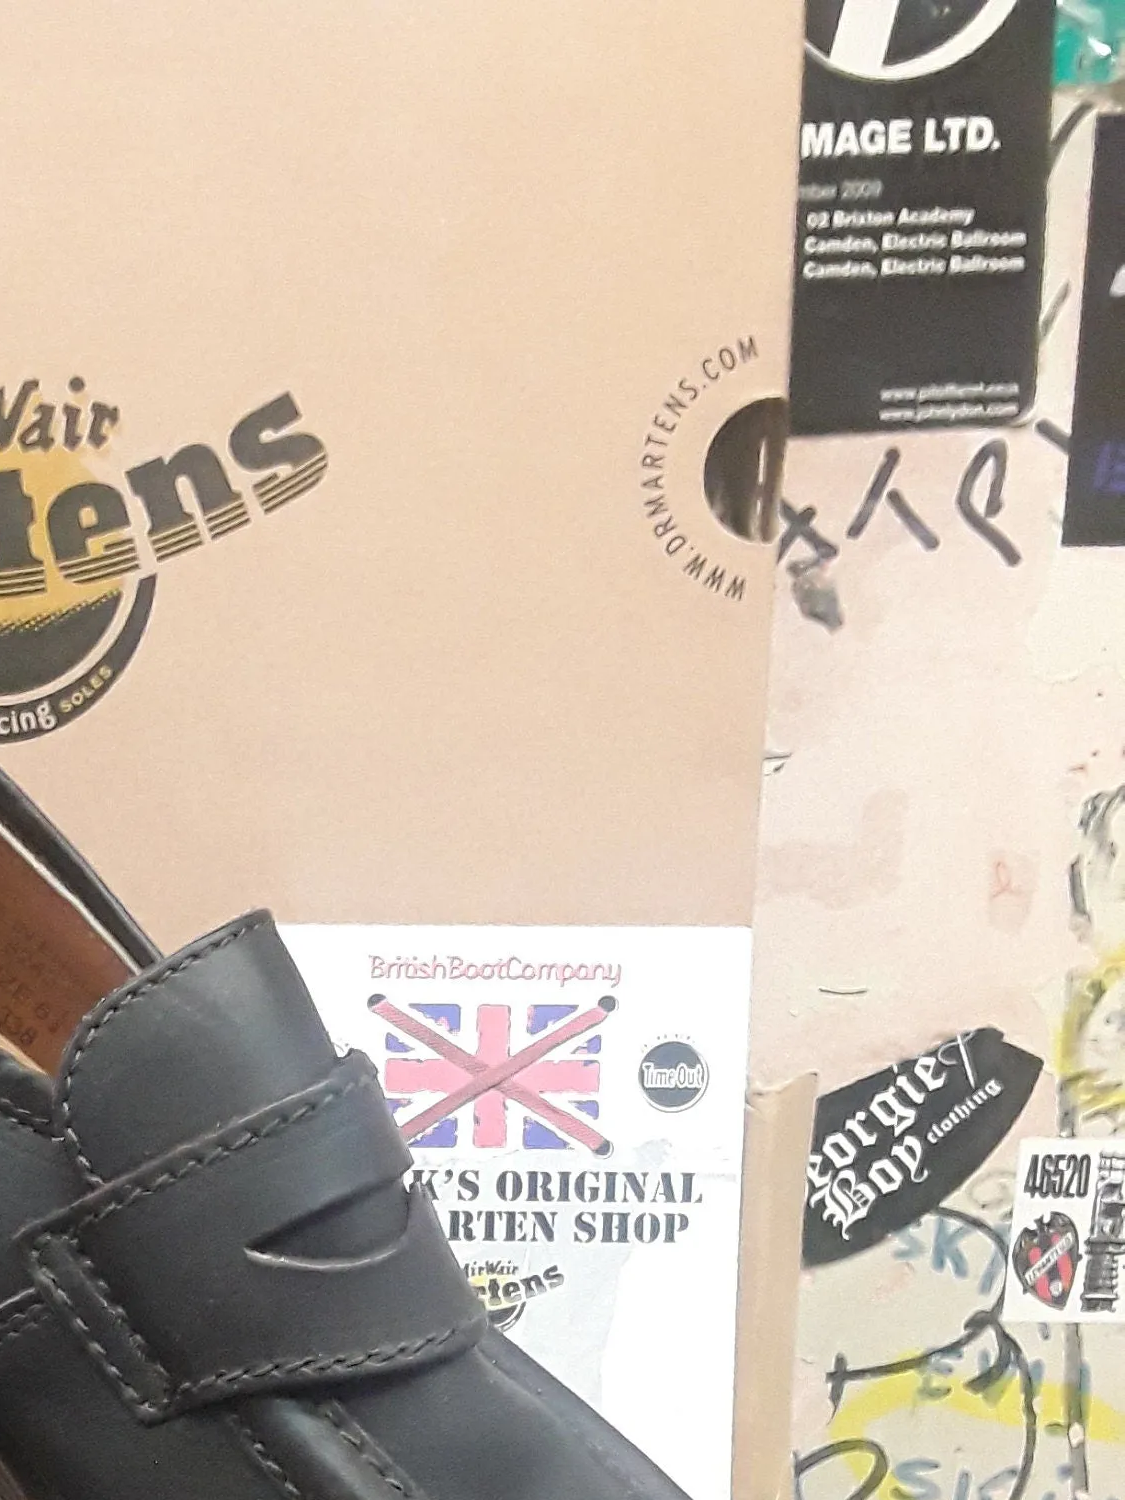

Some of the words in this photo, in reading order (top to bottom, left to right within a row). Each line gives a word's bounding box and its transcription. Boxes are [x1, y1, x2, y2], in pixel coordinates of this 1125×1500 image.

[924, 115, 1002, 153] LTD.
[897, 205, 976, 228] Academy
[881, 231, 948, 252] Electric
[950, 228, 1027, 250] Ballroom
[880, 256, 947, 277] Electric
[949, 253, 1025, 274] Ballroom
[639, 334, 759, 601] WWW.DRMARTENS.COM
[495, 1169, 704, 1205] ORIGINAL
[1023, 1153, 1091, 1199] 46520
[448, 1209, 559, 1243] RTEN
[573, 1210, 690, 1245] SHOP
